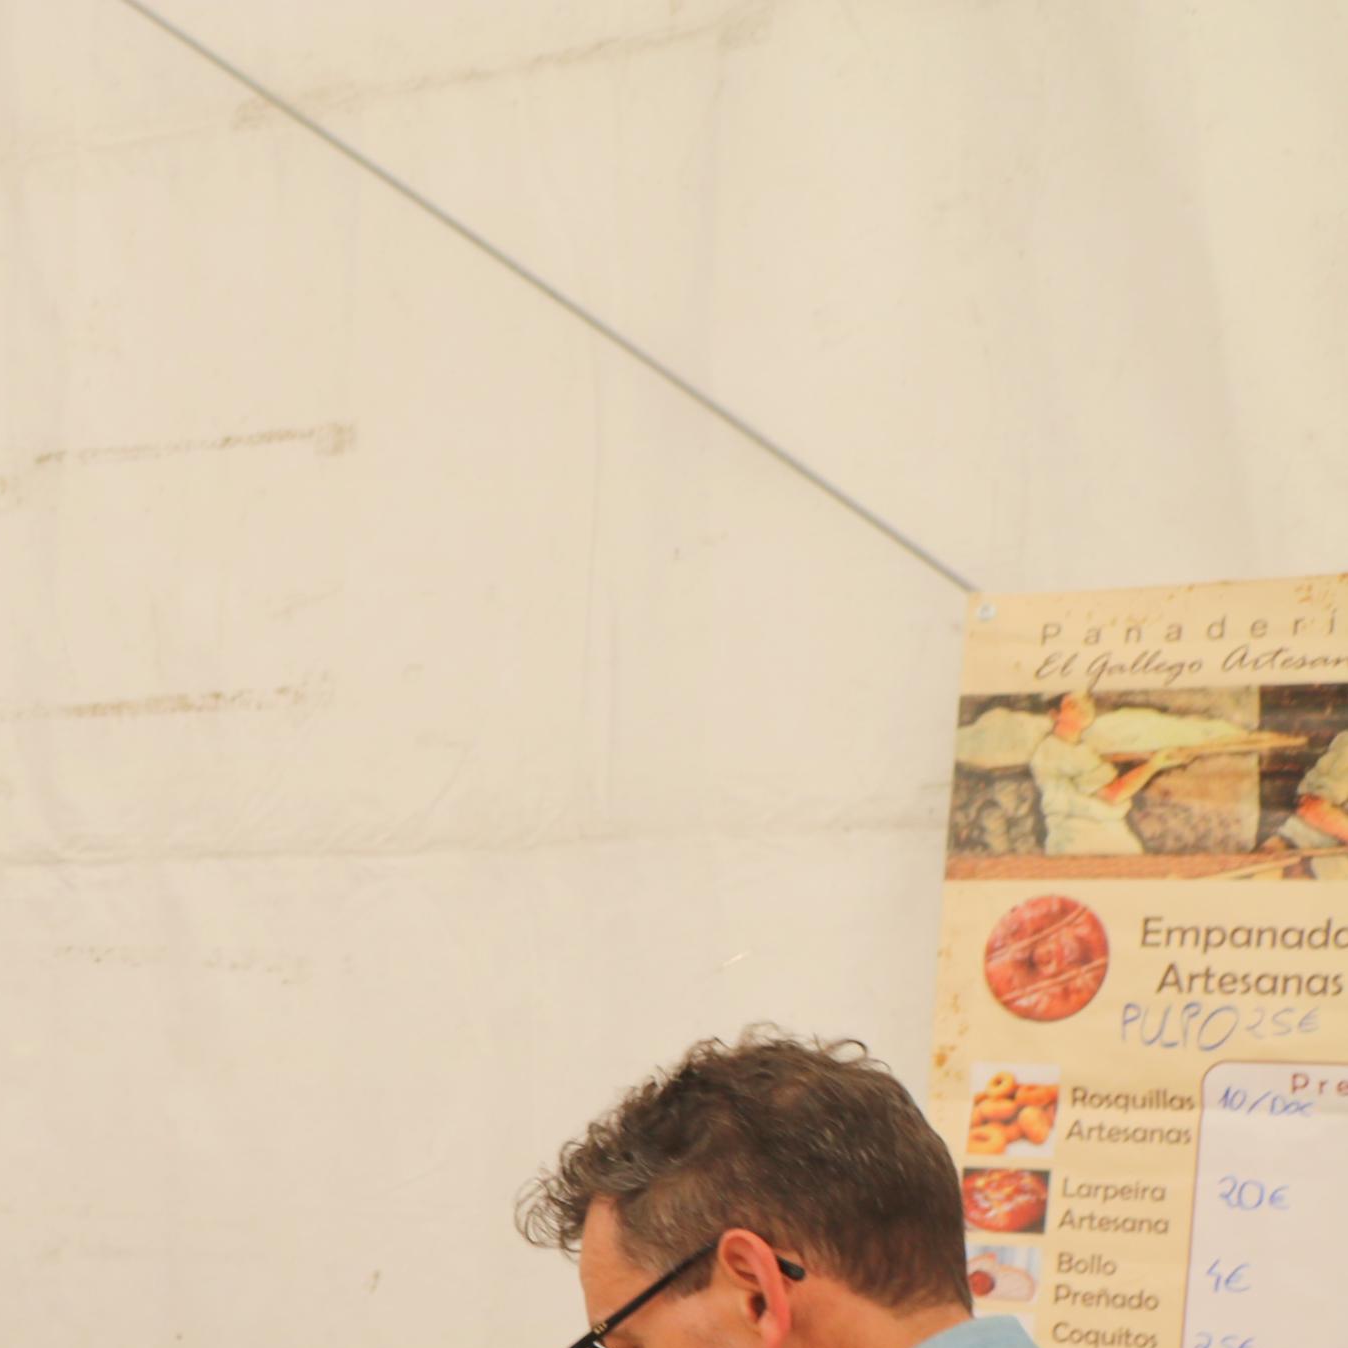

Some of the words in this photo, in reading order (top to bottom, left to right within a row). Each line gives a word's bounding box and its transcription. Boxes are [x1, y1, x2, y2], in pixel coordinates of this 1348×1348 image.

[1034, 651, 1079, 681] El
[1086, 649, 1203, 694] Gallego
[1156, 962, 1343, 996] Artesanas
[1121, 1001, 1240, 1052] PULPO
[1071, 1086, 1196, 1114] Rosquillas
[1065, 1119, 1193, 1145] Artesanas
[1061, 1177, 1167, 1204] Larpeira
[1218, 1174, 1290, 1213] 20€
[1057, 1208, 1170, 1236] Artesana
[1056, 1251, 1117, 1277] Bollo
[1053, 1284, 1159, 1312] Preñado
